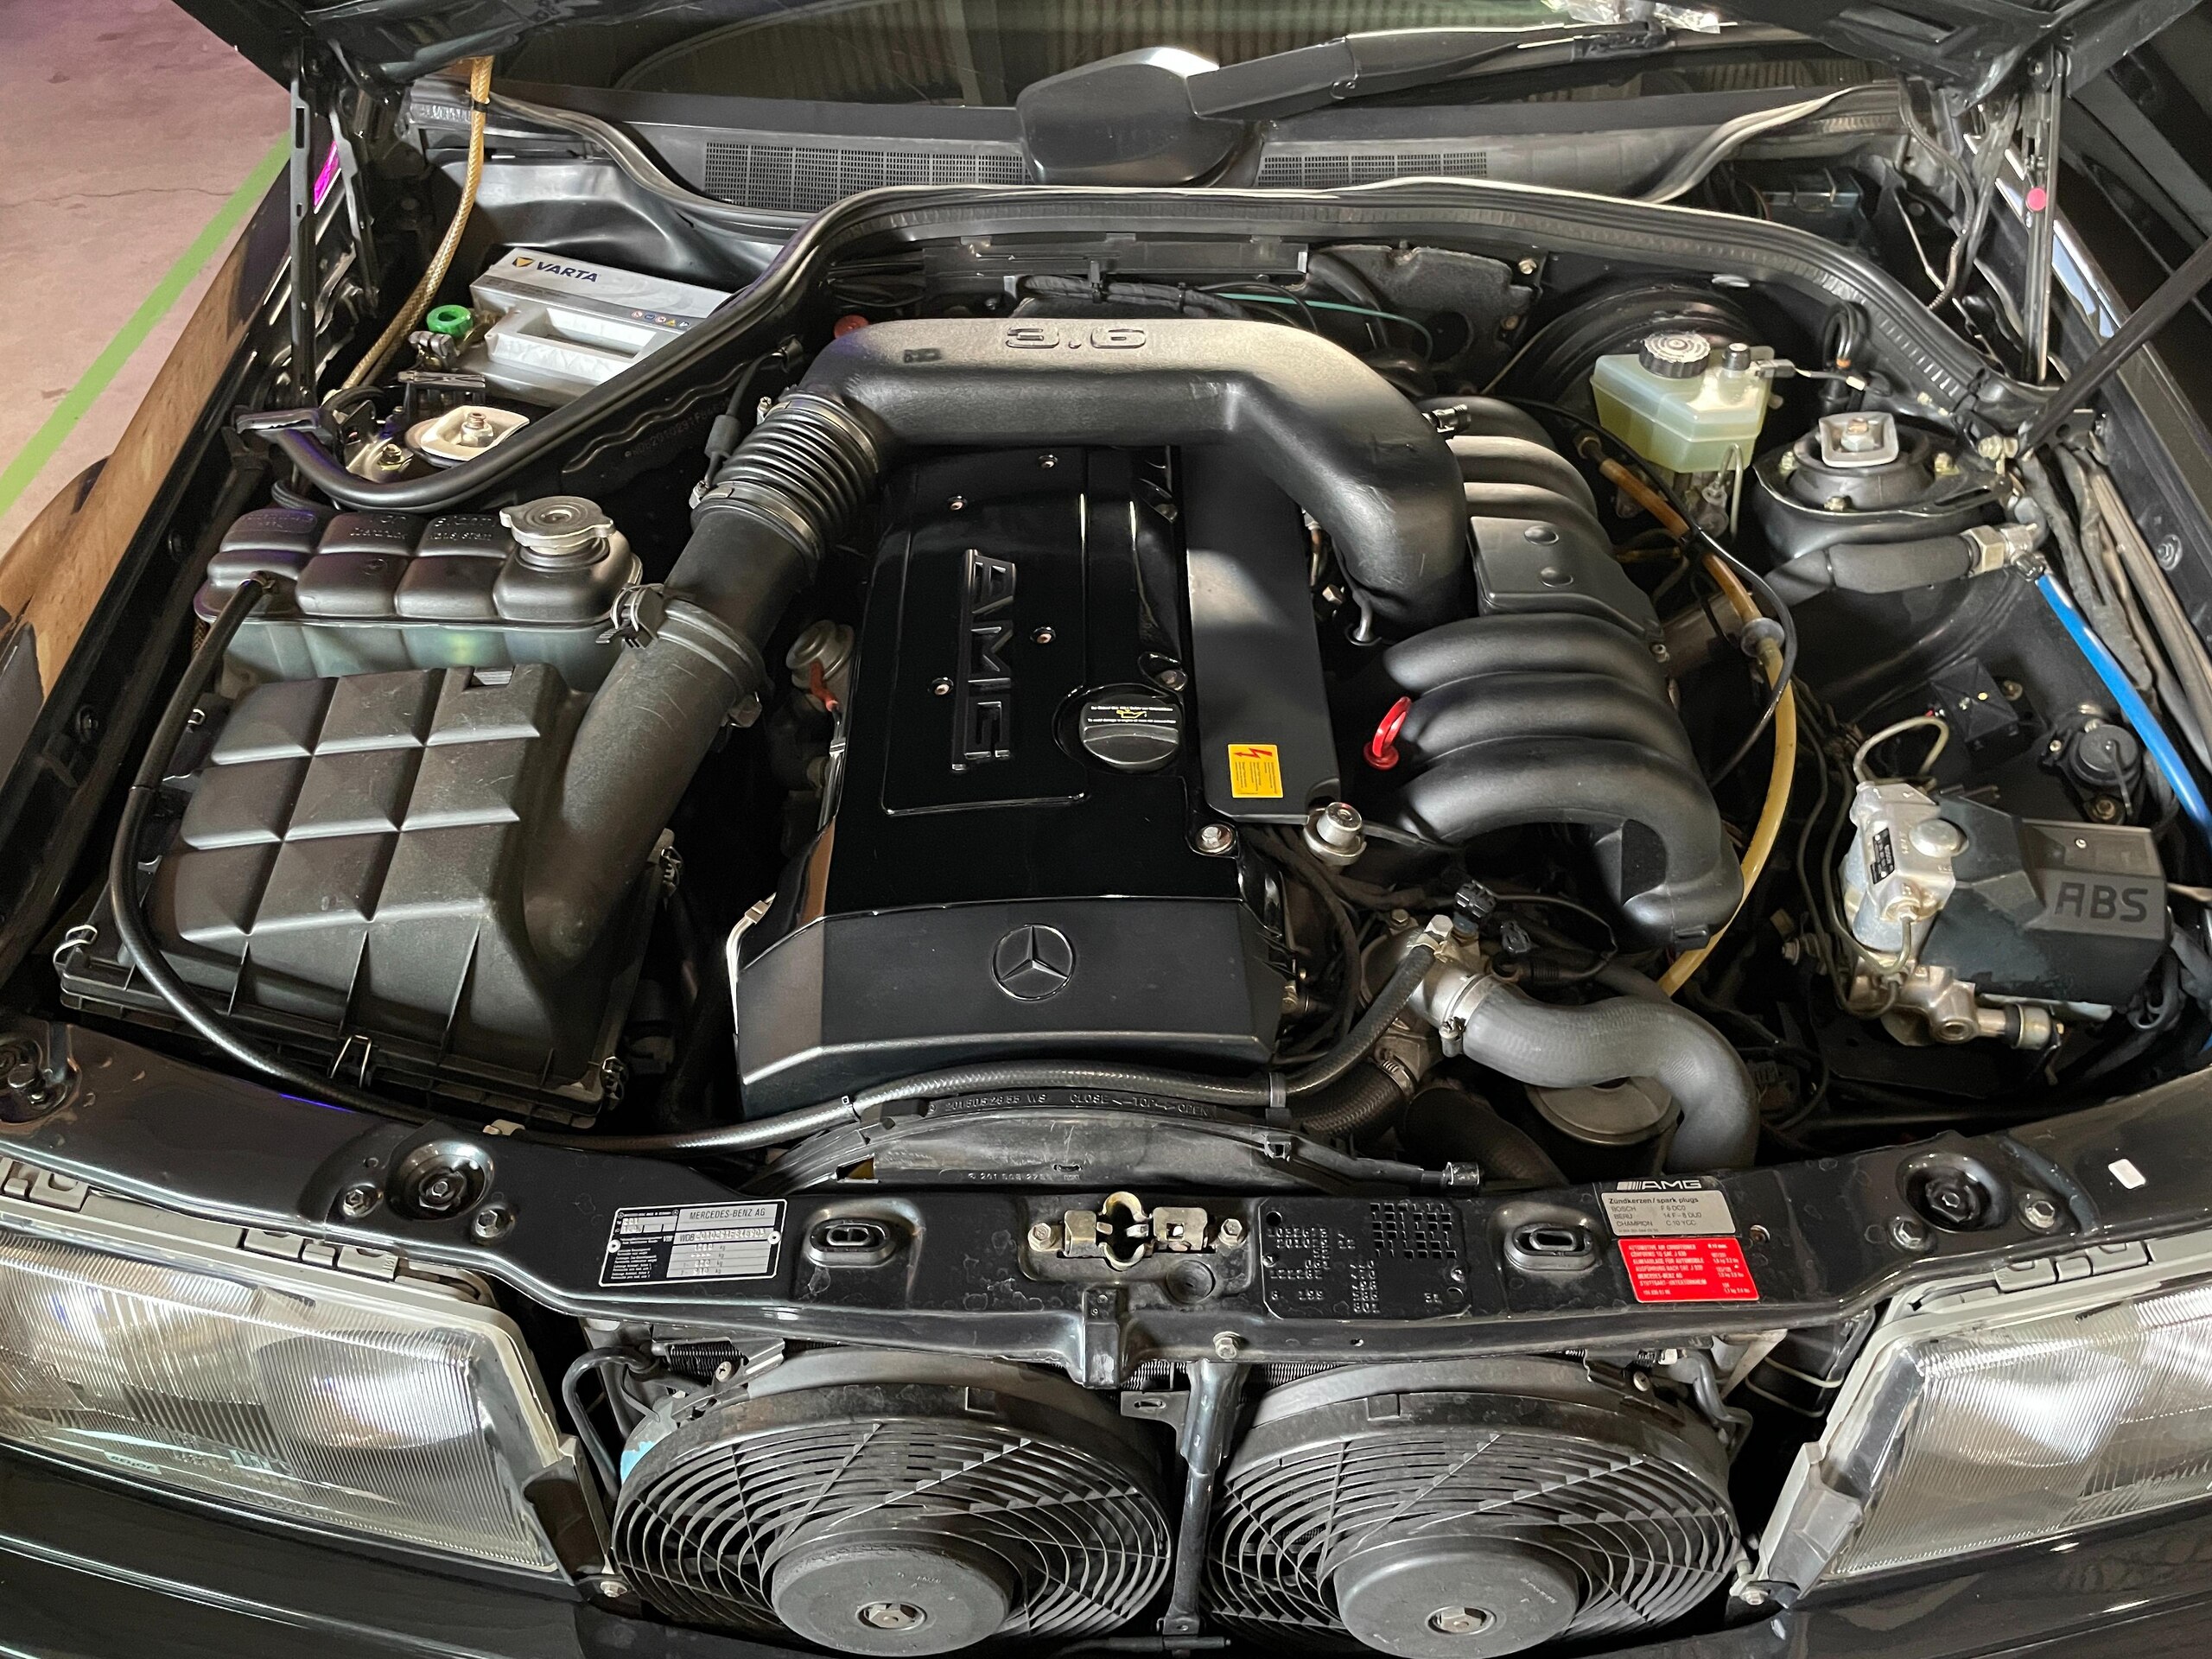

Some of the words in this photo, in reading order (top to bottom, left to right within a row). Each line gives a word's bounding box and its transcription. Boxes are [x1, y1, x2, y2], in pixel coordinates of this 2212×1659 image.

[537, 261, 599, 283] VARTA
[1005, 327, 1147, 349] 3.6
[962, 551, 1017, 761] AMG
[2055, 881, 2148, 923] ABS
[1027, 1094, 1047, 1103] WS
[1070, 1094, 1109, 1104] CLOSE
[1133, 1096, 1155, 1108] TOP
[1178, 1103, 1208, 1116] OPEN
[1642, 1179, 1702, 1190] AMG
[689, 1209, 753, 1220] MERCEDES-BENZ
[754, 1208, 766, 1217] AG
